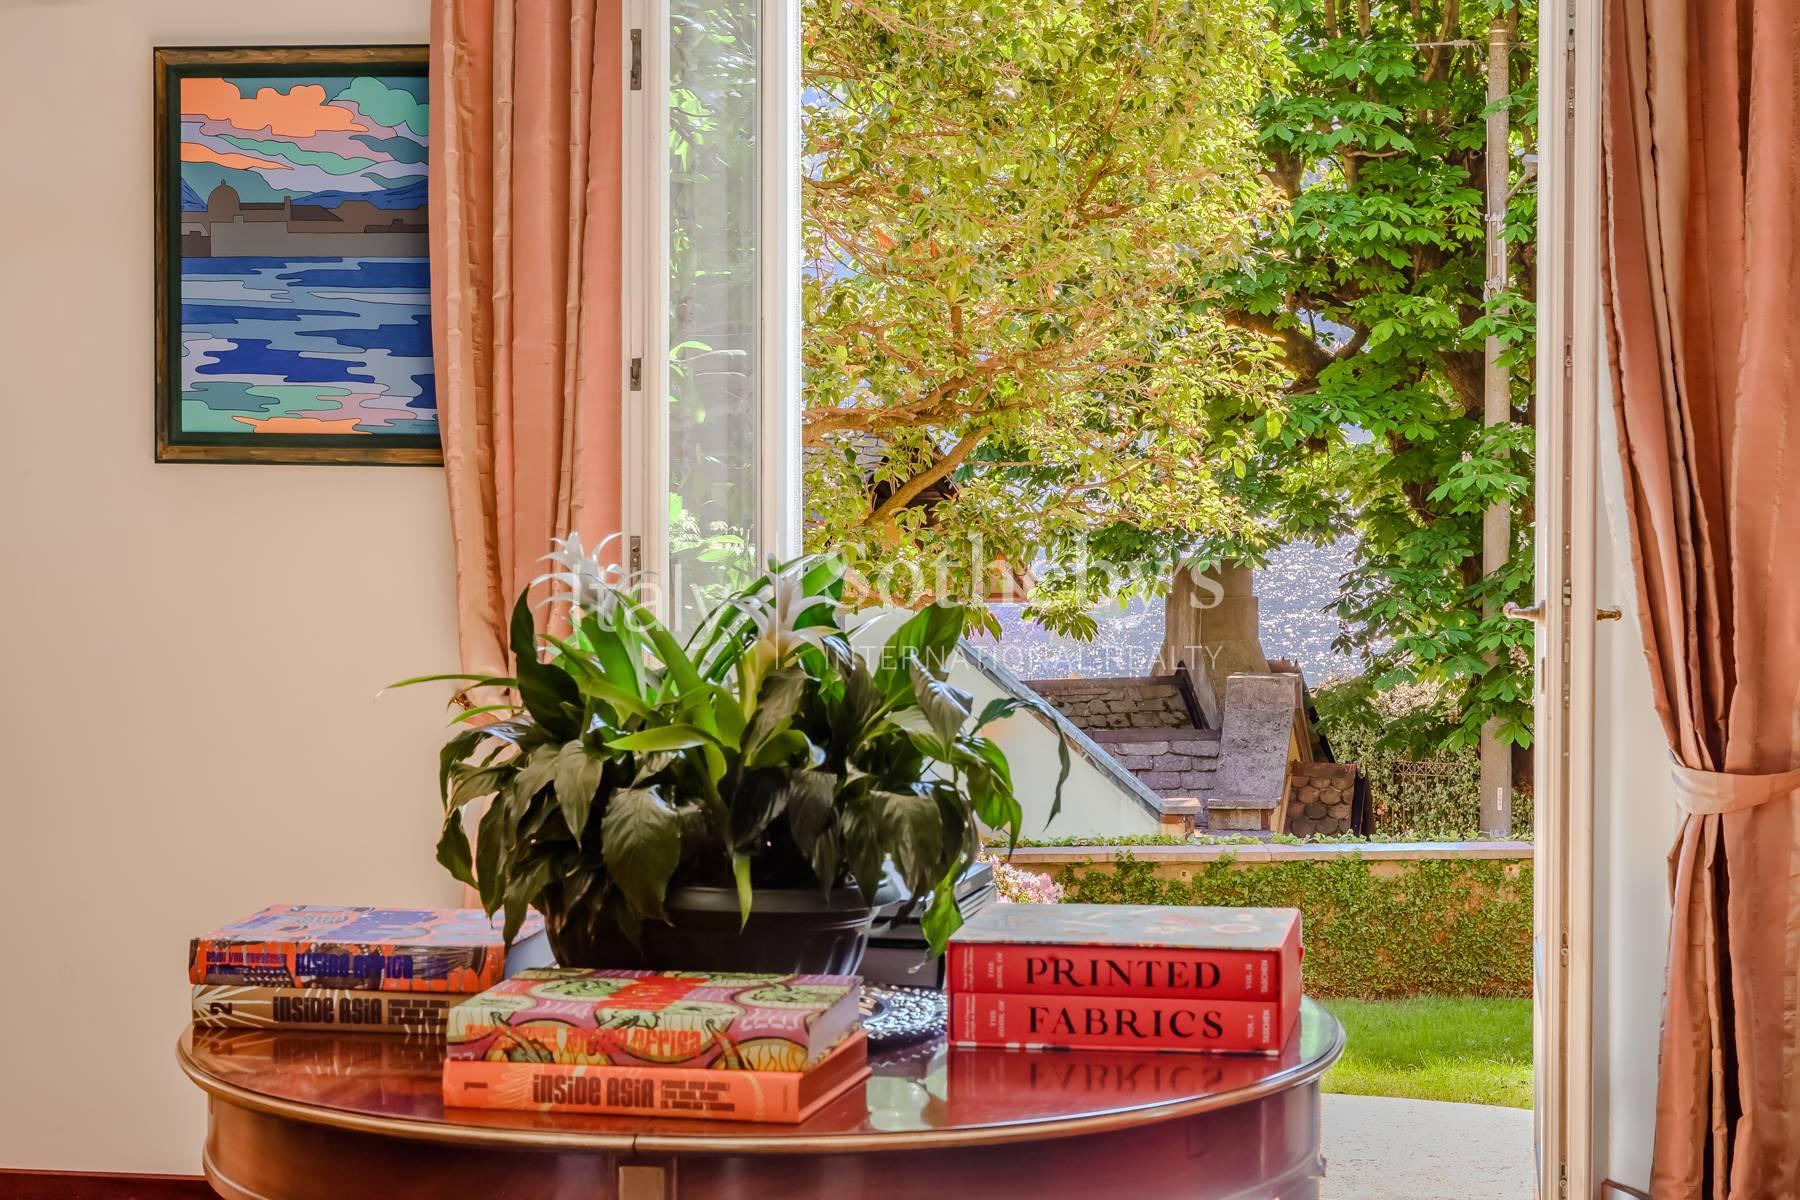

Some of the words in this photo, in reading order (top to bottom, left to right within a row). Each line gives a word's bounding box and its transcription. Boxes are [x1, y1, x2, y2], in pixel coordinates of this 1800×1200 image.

[1025, 957, 1221, 990] PRINTED
[1260, 959, 1269, 993] TASCHEN
[1028, 1006, 1223, 1039] FABRICS
[1261, 1009, 1270, 1044] TASCHEN
